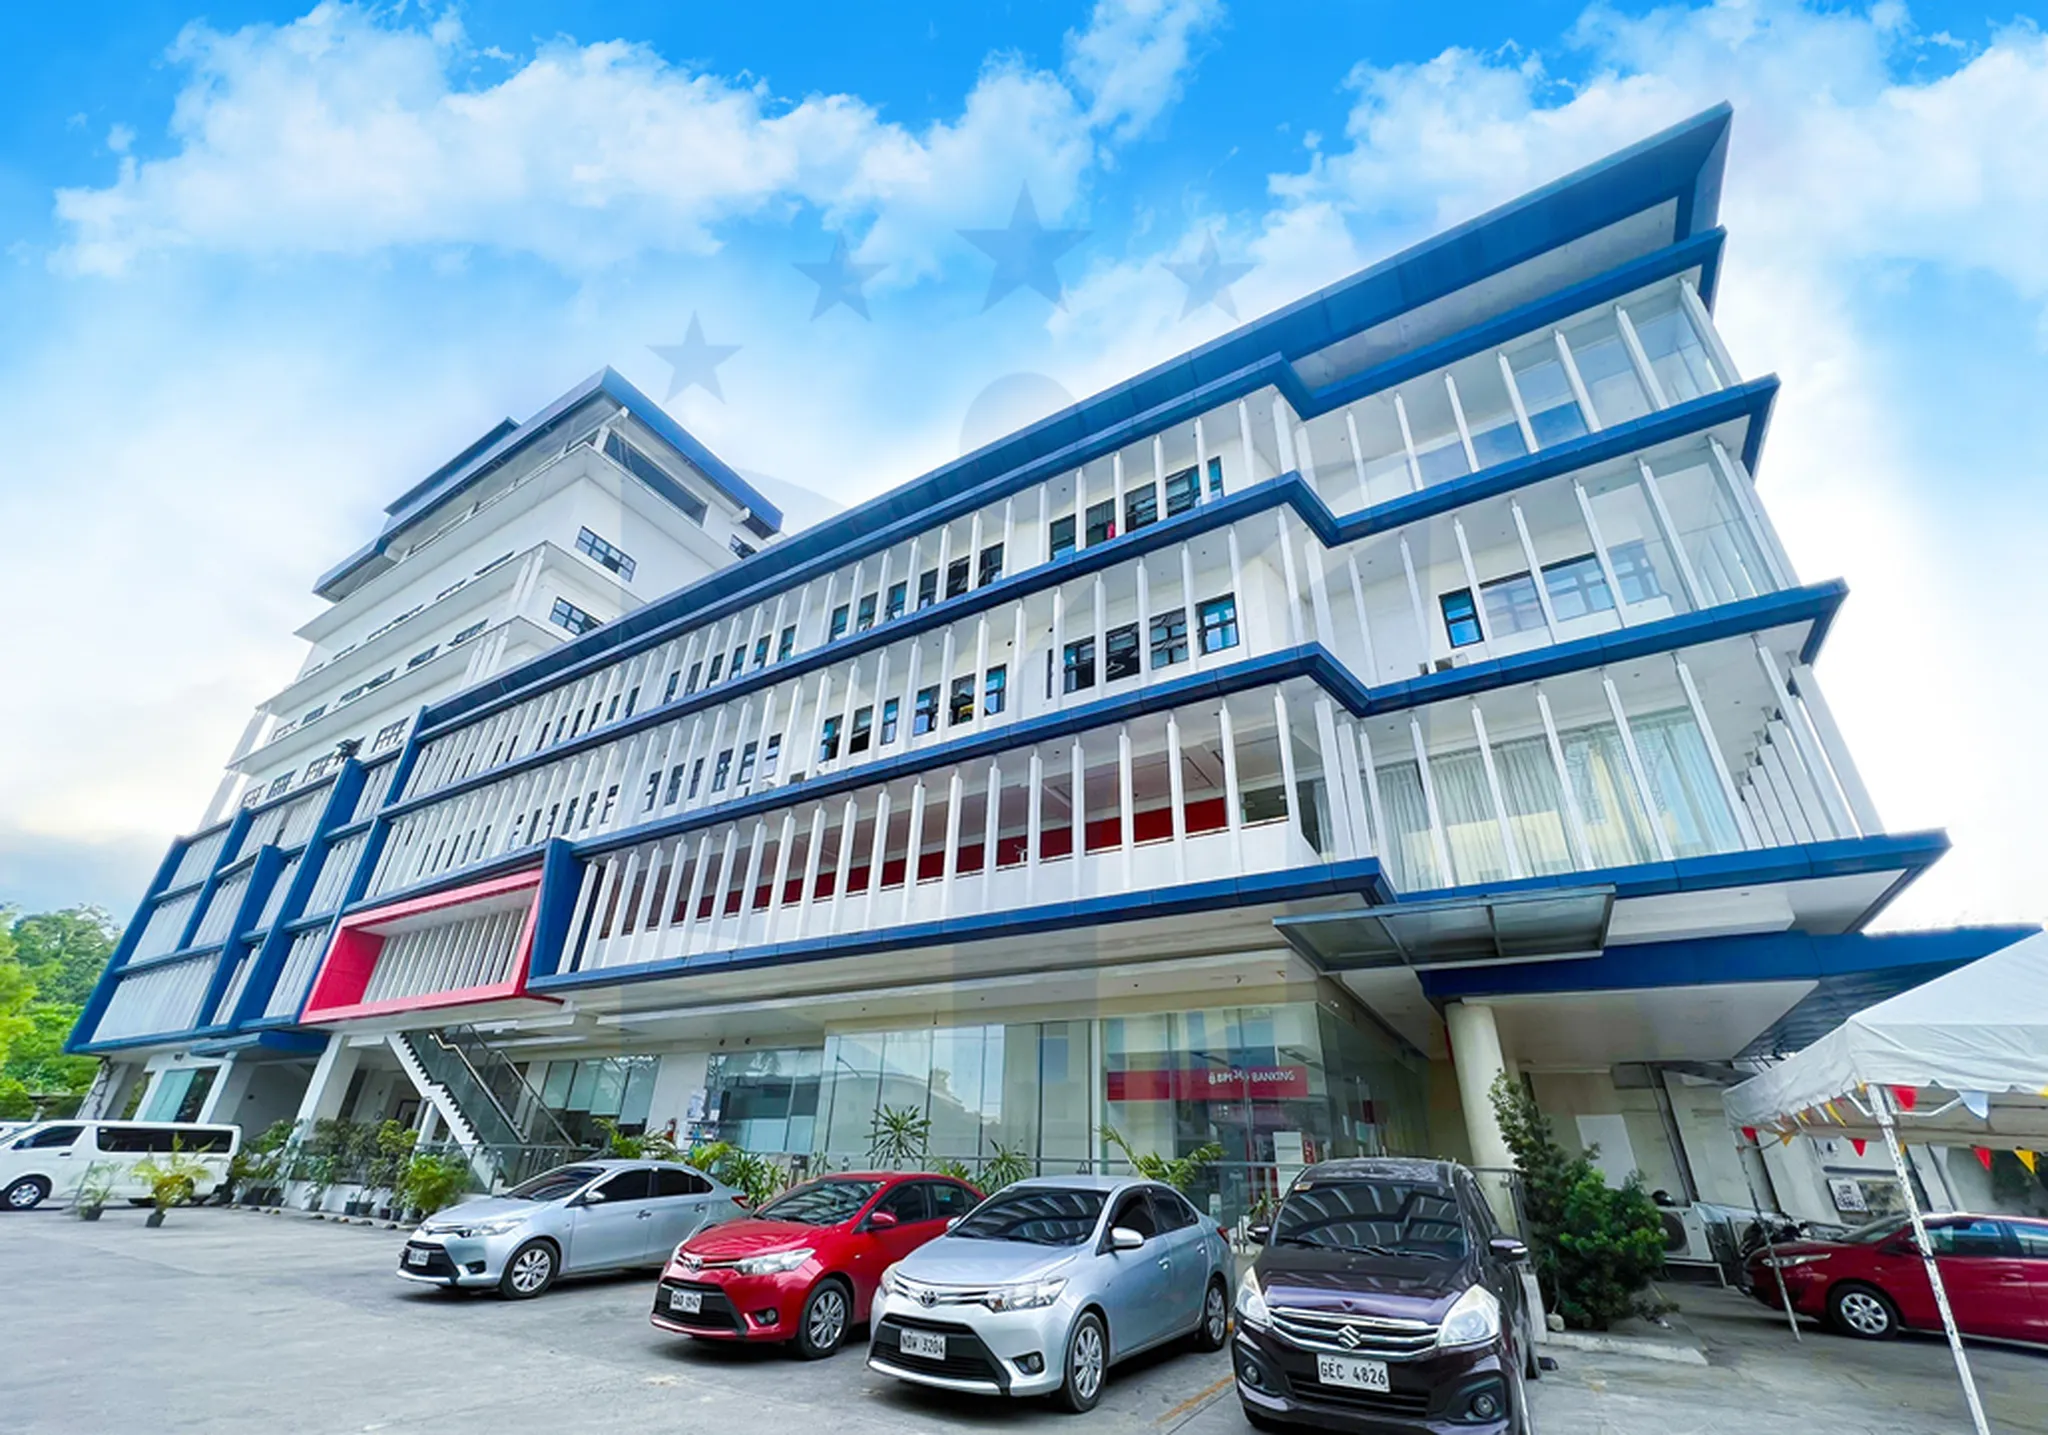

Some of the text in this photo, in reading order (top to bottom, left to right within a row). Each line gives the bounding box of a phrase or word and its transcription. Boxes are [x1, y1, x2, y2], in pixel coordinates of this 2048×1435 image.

[1251, 1070, 1296, 1083] BANKING
[1320, 1361, 1386, 1386] GEC 4826
